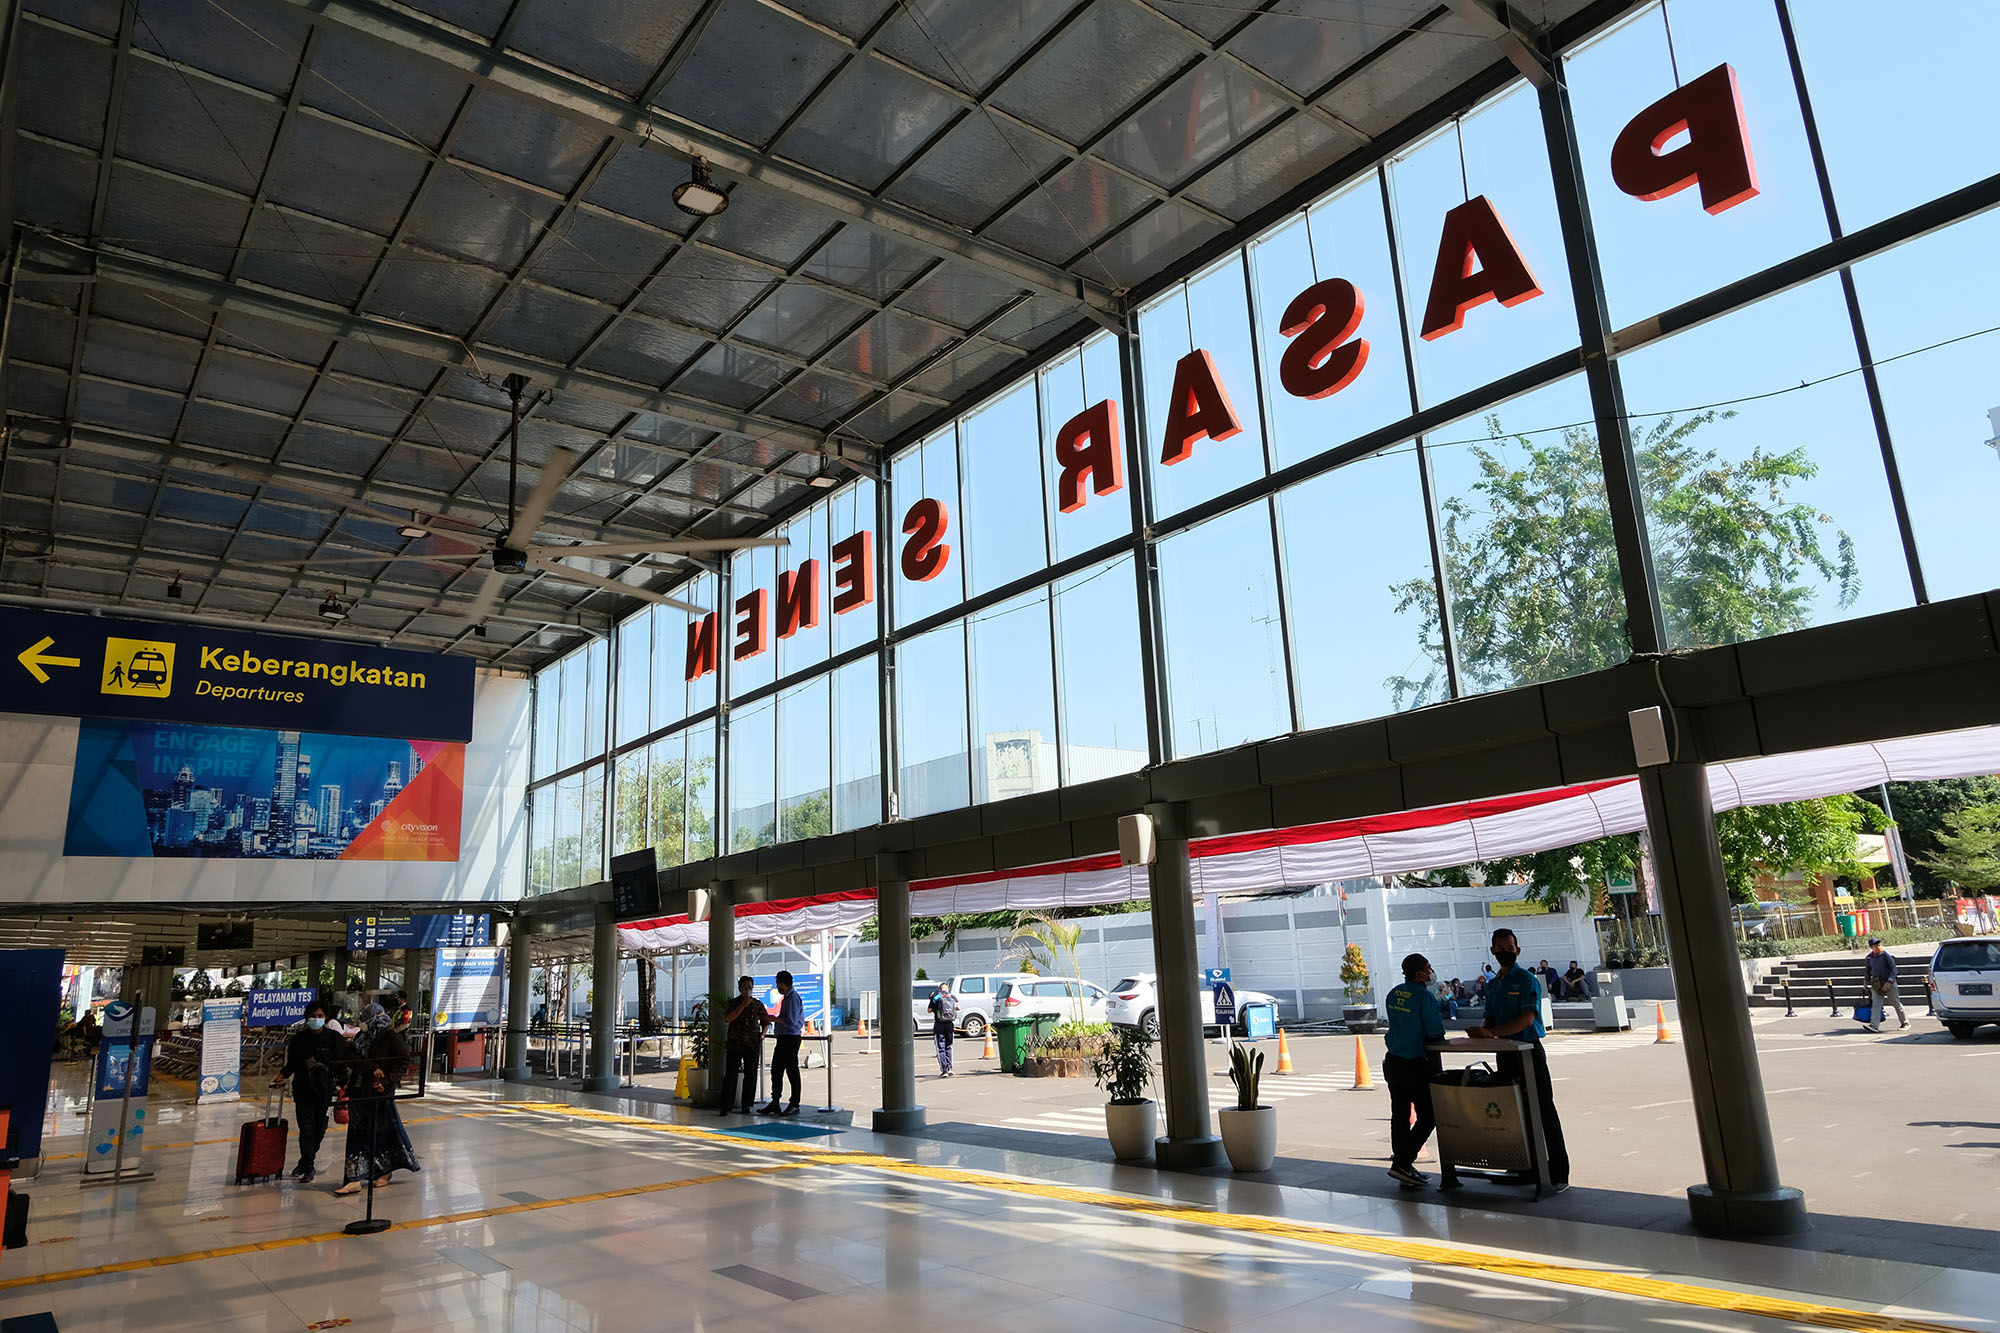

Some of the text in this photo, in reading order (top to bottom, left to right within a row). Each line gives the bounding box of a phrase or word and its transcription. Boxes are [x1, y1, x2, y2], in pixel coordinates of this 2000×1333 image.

[199, 646, 426, 690] Keberangkatan
[195, 680, 305, 704] Departures
[401, 823, 438, 832] cityvision
[253, 991, 312, 1004] PELAYANAN TES
[252, 1005, 306, 1019] Antigen / Vaksi
